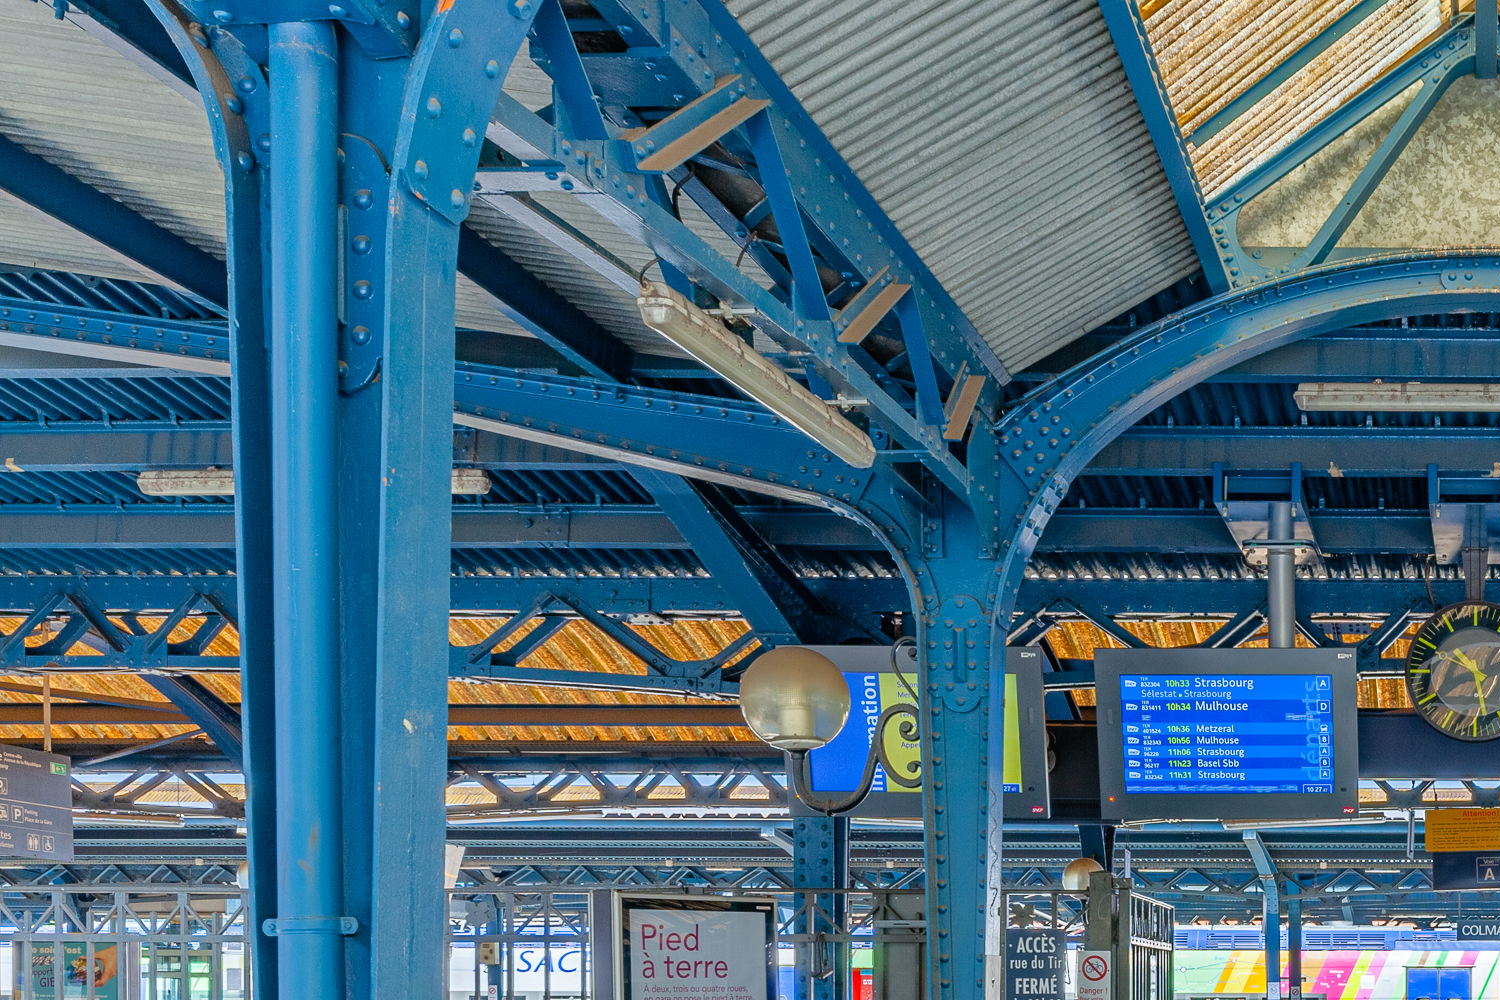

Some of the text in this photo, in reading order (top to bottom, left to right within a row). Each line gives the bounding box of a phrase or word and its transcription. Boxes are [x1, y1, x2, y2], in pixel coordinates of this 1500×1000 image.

[1194, 678, 1254, 690] Strasbourg
[1141, 689, 1232, 700] Sélestat Strasbourg
[1166, 703, 1191, 711] 10h34
[1195, 701, 1248, 711] Mulhouse
[1320, 703, 1327, 711] D
[1167, 725, 1190, 733] 10h36
[1196, 725, 1235, 733] Metzeral
[1196, 736, 1240, 745] Mulhouse
[1197, 748, 1245, 758] Strasbourg
[1197, 759, 1221, 768] Basel
[1223, 759, 1240, 768] Sbb
[1198, 771, 1245, 781] Strasbourg
[1484, 868, 1496, 880] A
[641, 924, 699, 951] Pied
[1016, 933, 1056, 953] ACCÈS
[642, 952, 728, 979] à terre
[1010, 955, 1062, 969] rue du Tir
[643, 983, 749, 994] À deux, trois ou quatre roues,
[1015, 974, 1058, 994] FERMÉ
[1079, 987, 1103, 995] Danger
